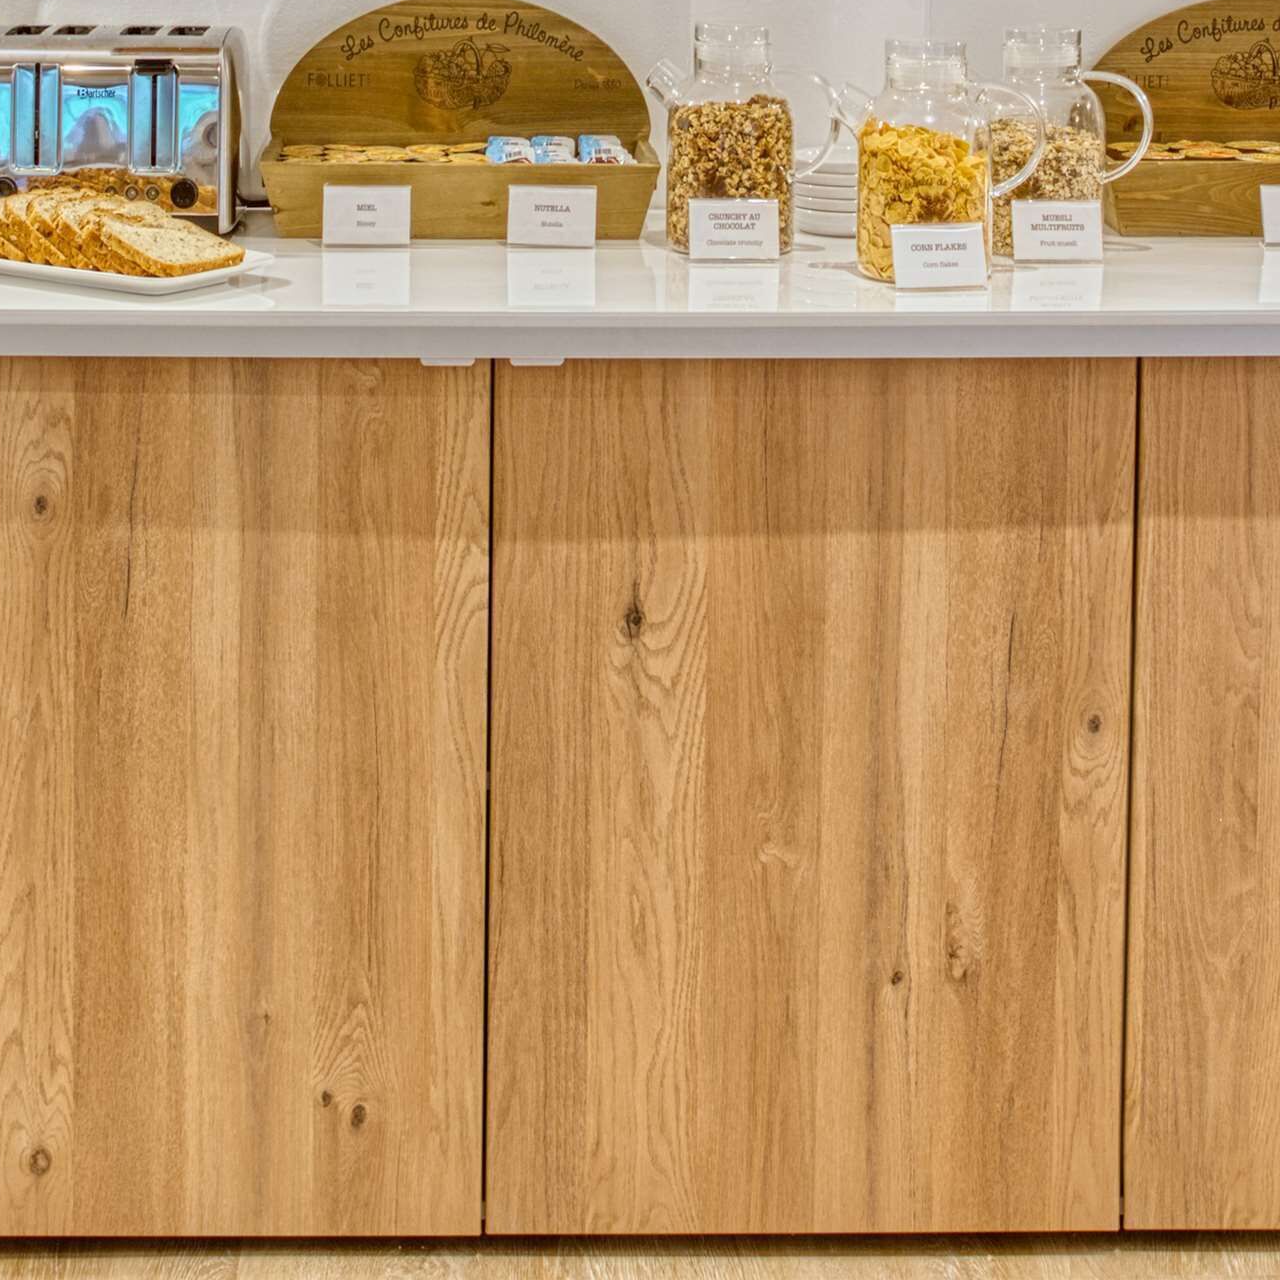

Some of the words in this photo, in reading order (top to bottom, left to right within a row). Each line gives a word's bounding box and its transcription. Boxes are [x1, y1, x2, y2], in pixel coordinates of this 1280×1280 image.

[340, 35, 374, 62] Les
[378, 13, 469, 41] Confitures
[476, 12, 497, 32] de
[504, 11, 584, 62] Philomène
[1140, 37, 1173, 63] Les
[1177, 15, 1266, 44] Confitures
[534, 204, 571, 212] NUTELLA
[708, 213, 747, 221] CRUNCHY
[749, 213, 761, 221] AU
[910, 244, 933, 252] CORN
[935, 243, 967, 251] FLAKES
